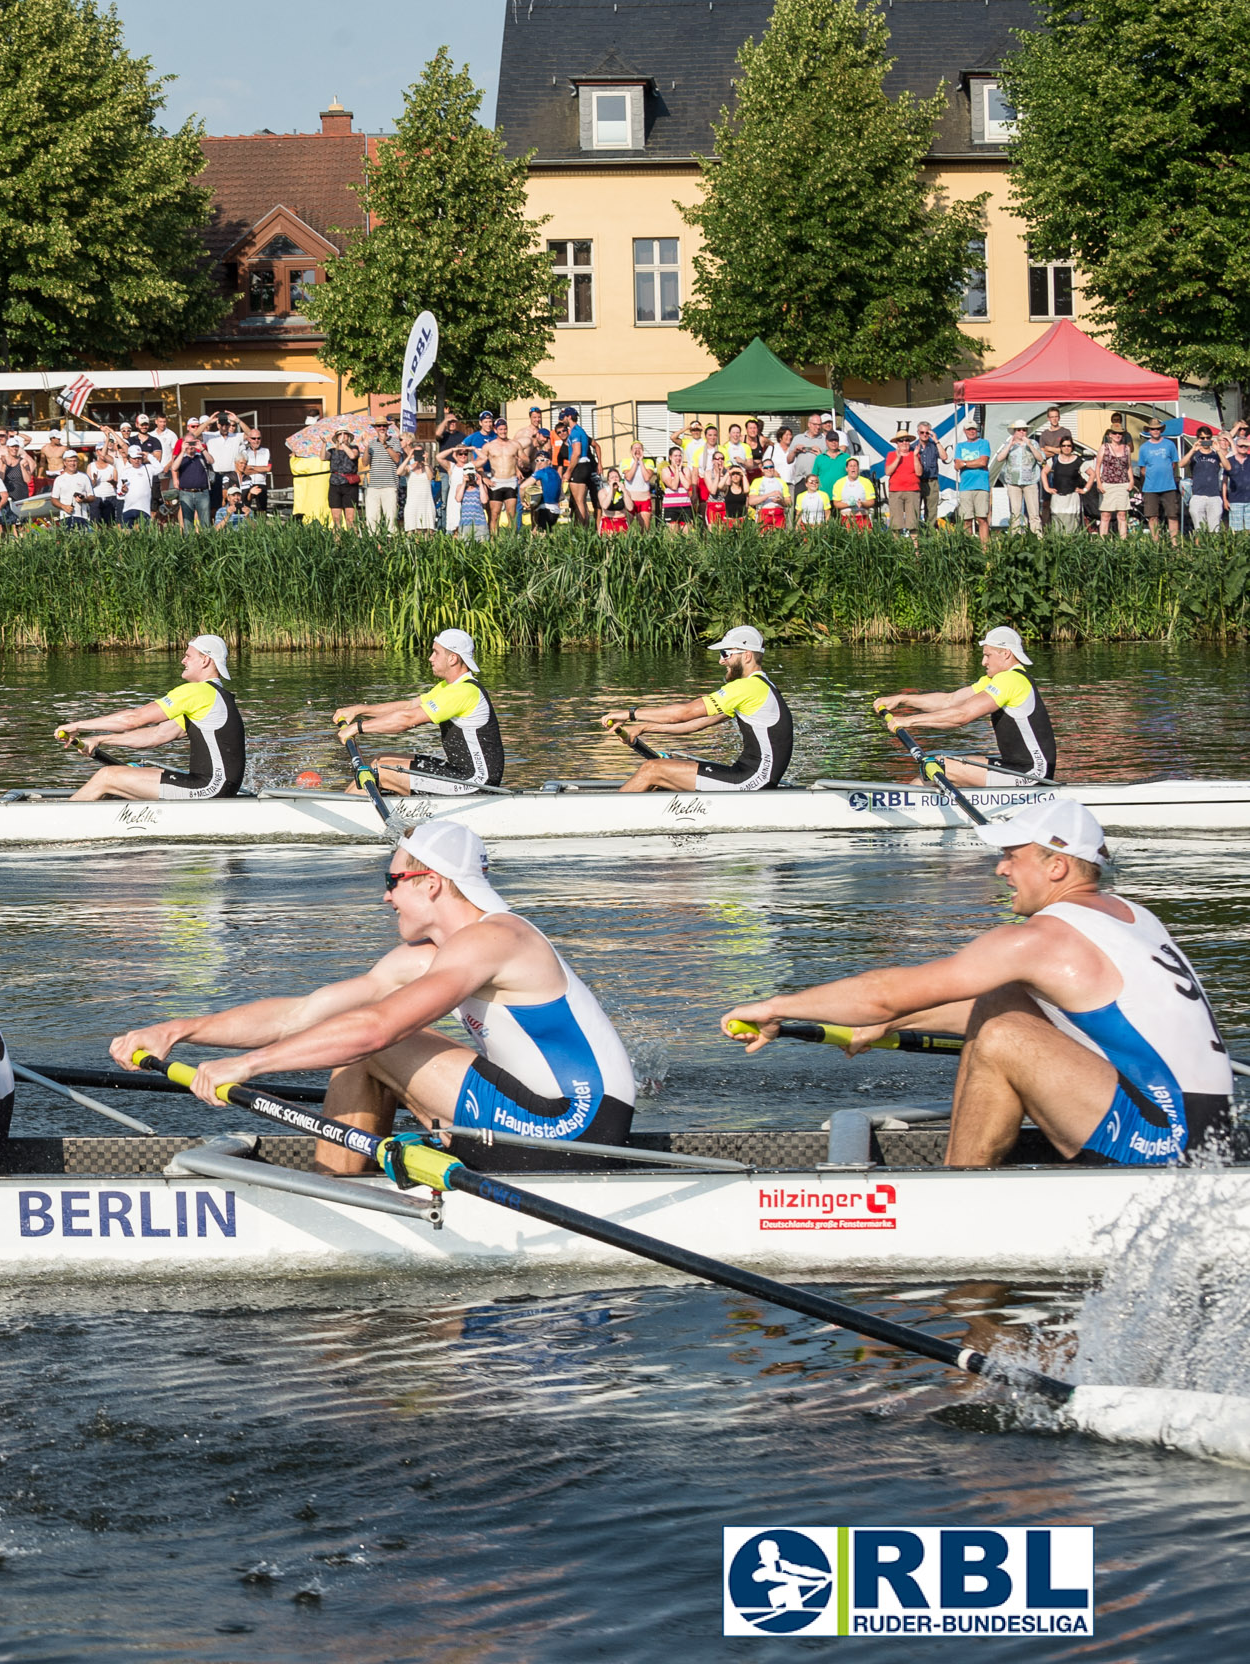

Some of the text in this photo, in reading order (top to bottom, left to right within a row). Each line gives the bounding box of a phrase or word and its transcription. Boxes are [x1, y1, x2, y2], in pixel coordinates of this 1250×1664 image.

[662, 794, 708, 815] Melitta
[872, 791, 916, 807] RBL
[113, 803, 158, 824] Melitta
[493, 1079, 592, 1139] Hauptstadtsprinter
[254, 1097, 372, 1152] STARK. SCHNELL. GUT. RBL
[759, 1189, 862, 1214] hilzinger
[18, 1190, 237, 1238] BERLIN
[762, 1220, 895, 1230] Deutschlands große Fenstermarke.
